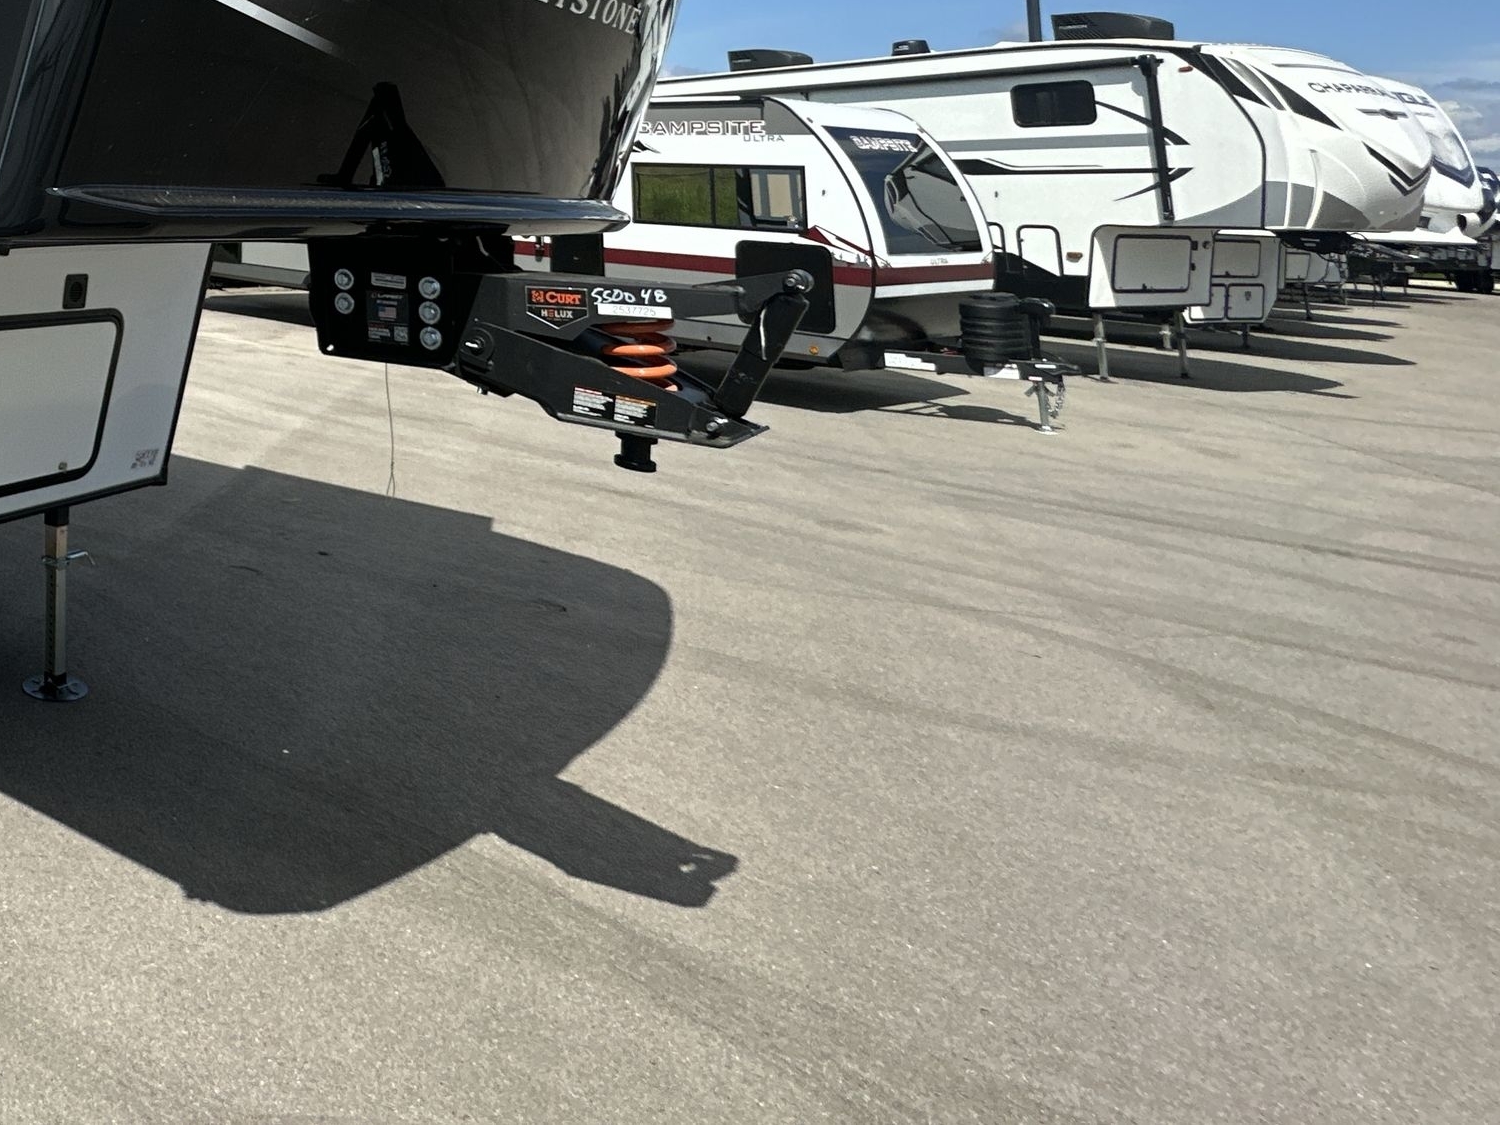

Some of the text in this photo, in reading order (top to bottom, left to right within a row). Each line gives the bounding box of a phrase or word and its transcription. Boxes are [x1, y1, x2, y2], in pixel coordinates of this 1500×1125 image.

[743, 134, 786, 143] ULTRA
[545, 290, 582, 305] CURT
[541, 308, 574, 319] HELUX
[612, 305, 657, 317] 2537725
